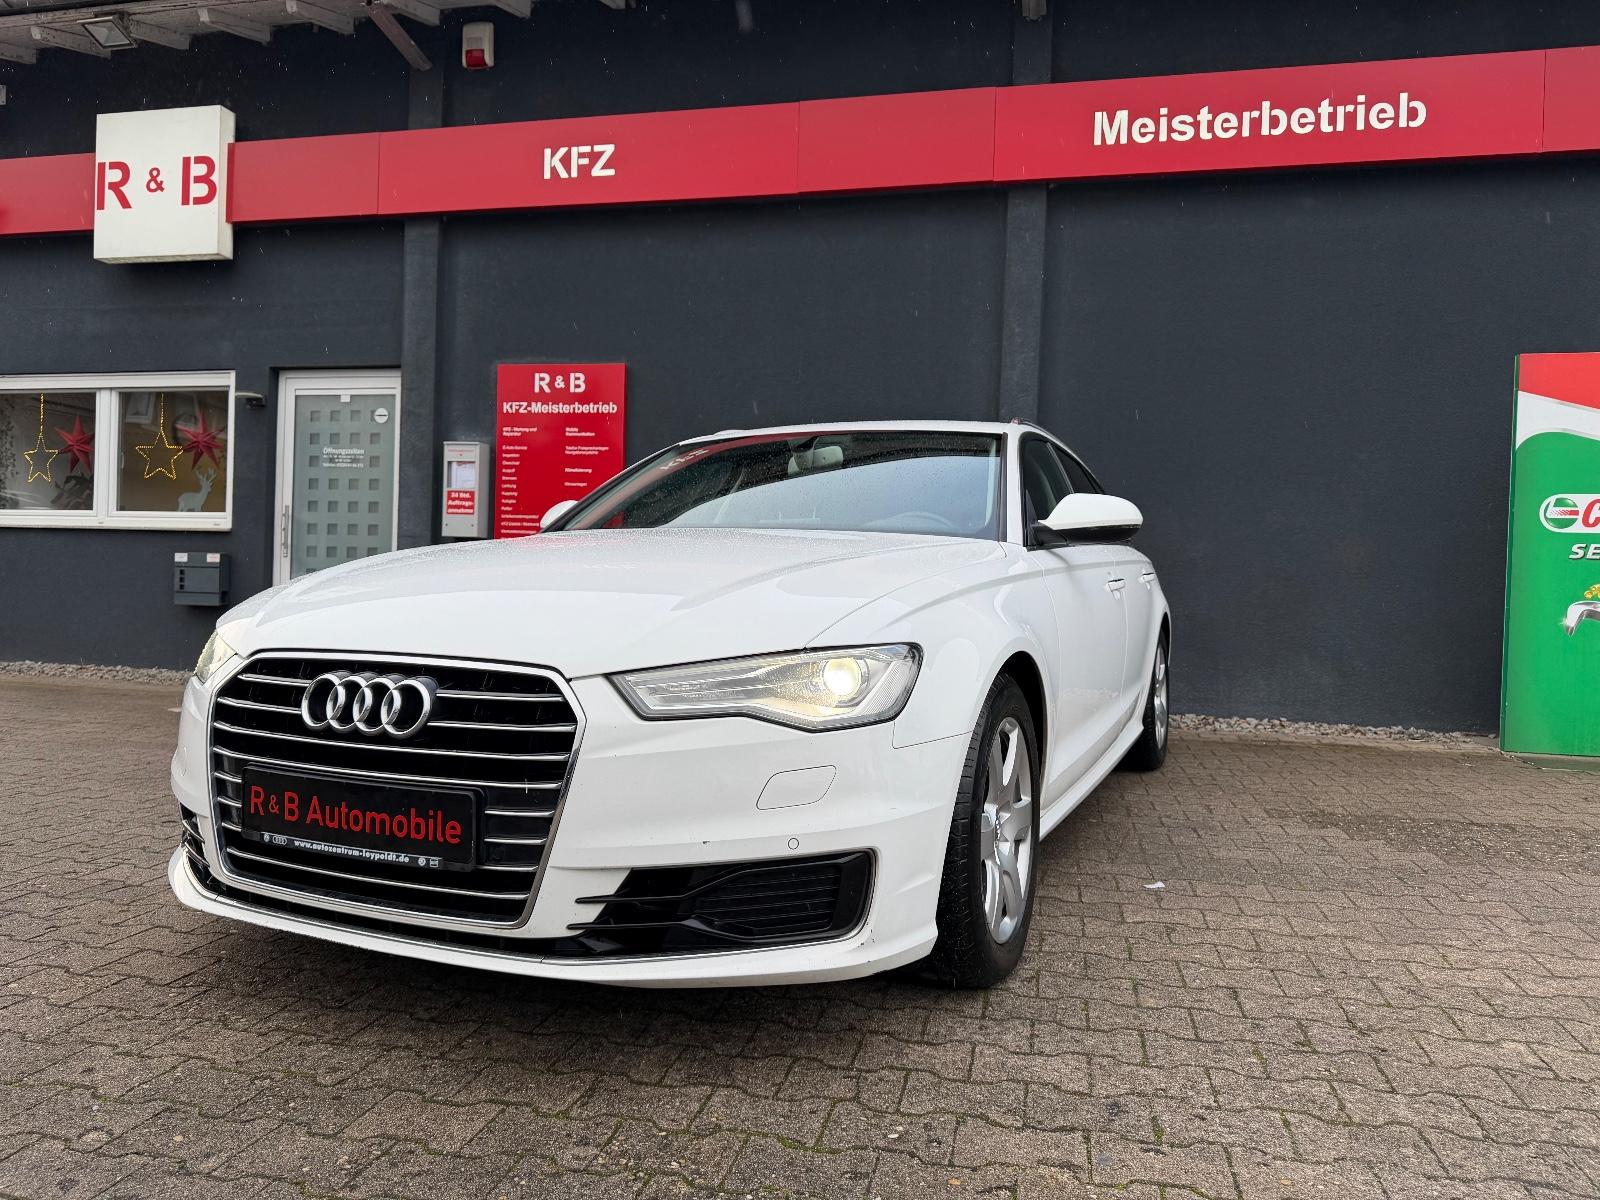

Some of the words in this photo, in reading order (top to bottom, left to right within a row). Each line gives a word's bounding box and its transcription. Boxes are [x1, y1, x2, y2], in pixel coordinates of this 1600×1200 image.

[1092, 92, 1427, 146] Meisterbetrieb
[543, 143, 616, 180] KFZ
[96, 161, 133, 211] R
[145, 167, 165, 193] &
[181, 155, 218, 206] B
[534, 372, 551, 393] R
[554, 375, 566, 389] &
[569, 372, 586, 393] B
[503, 401, 618, 414] KFZ-Meisterbetrieb
[306, 795, 462, 845] Automobile
[293, 839, 410, 864] www.autozentrum-leypoldt.de
